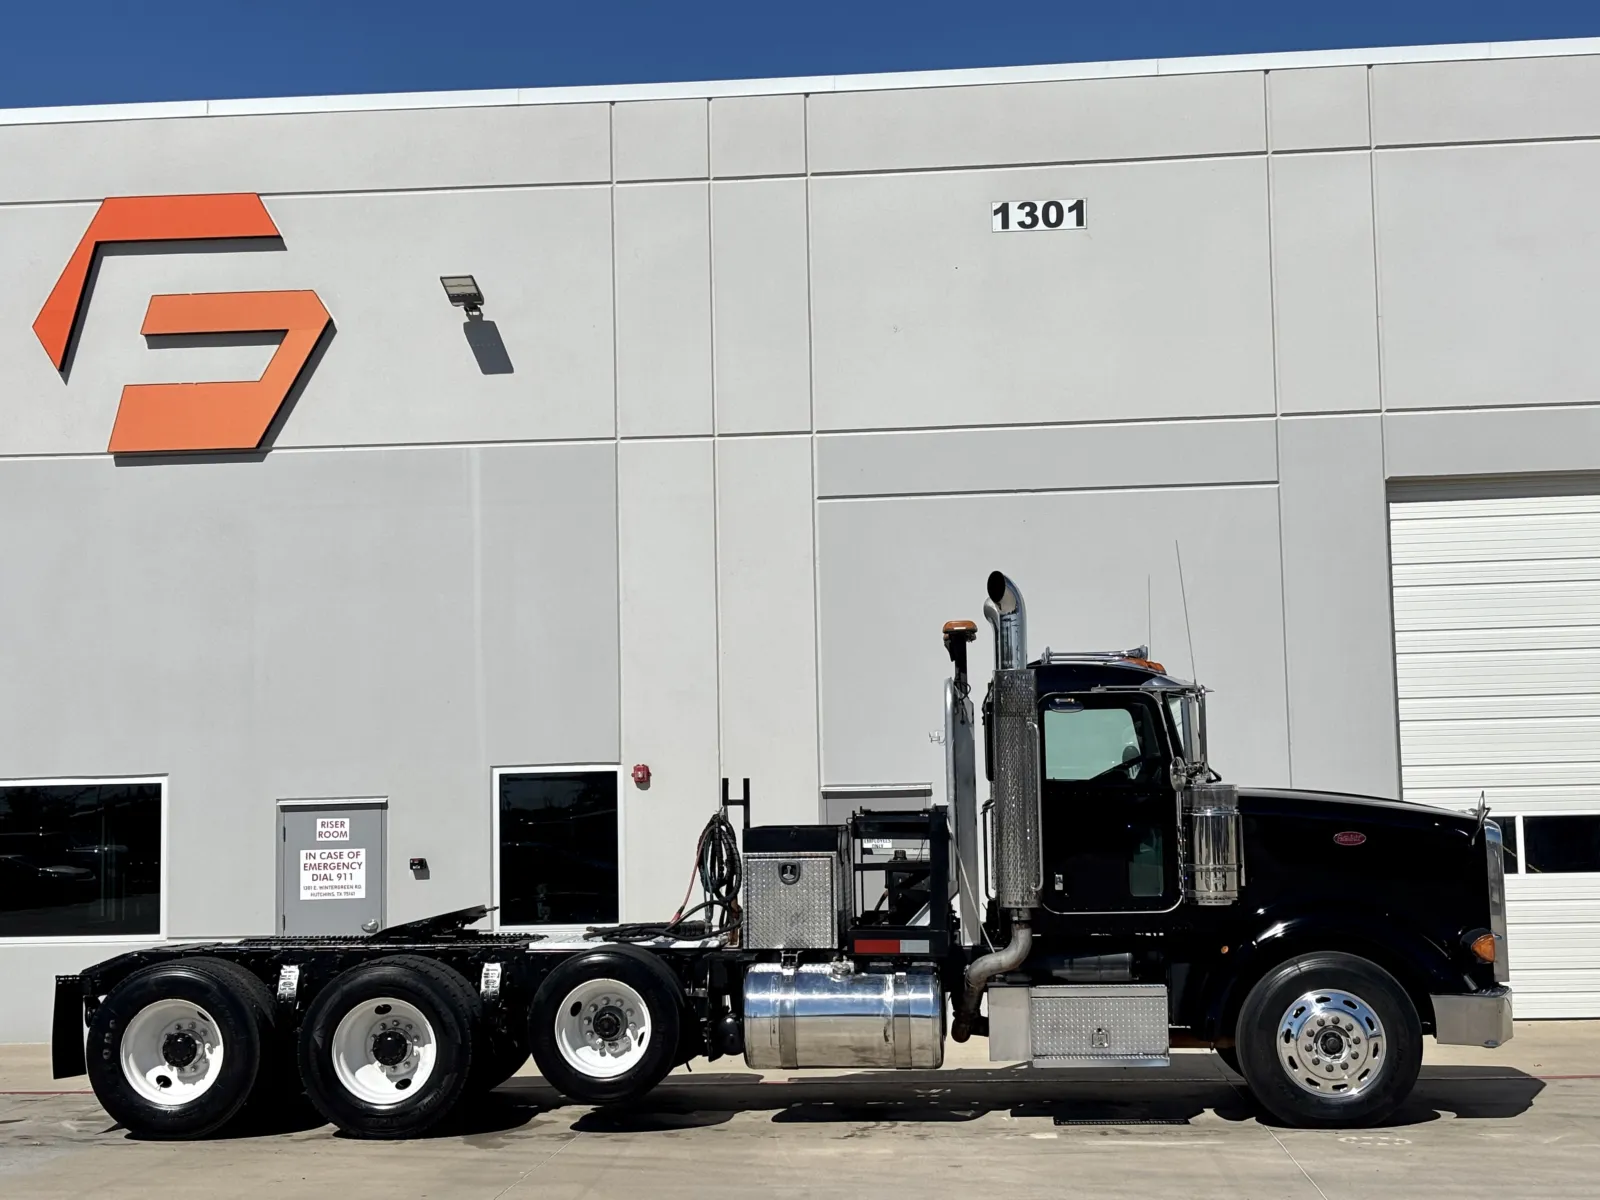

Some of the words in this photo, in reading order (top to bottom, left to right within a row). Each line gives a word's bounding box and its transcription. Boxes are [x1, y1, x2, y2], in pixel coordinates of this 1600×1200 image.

[993, 199, 1084, 230] 1301
[320, 820, 346, 828] RISER
[318, 830, 348, 839] ROOM
[305, 852, 317, 860] IN
[319, 851, 344, 860] CASE
[347, 850, 361, 859] OF
[303, 861, 363, 871] EMERGENCY
[311, 873, 334, 882] DIAL
[336, 872, 353, 881] 911
